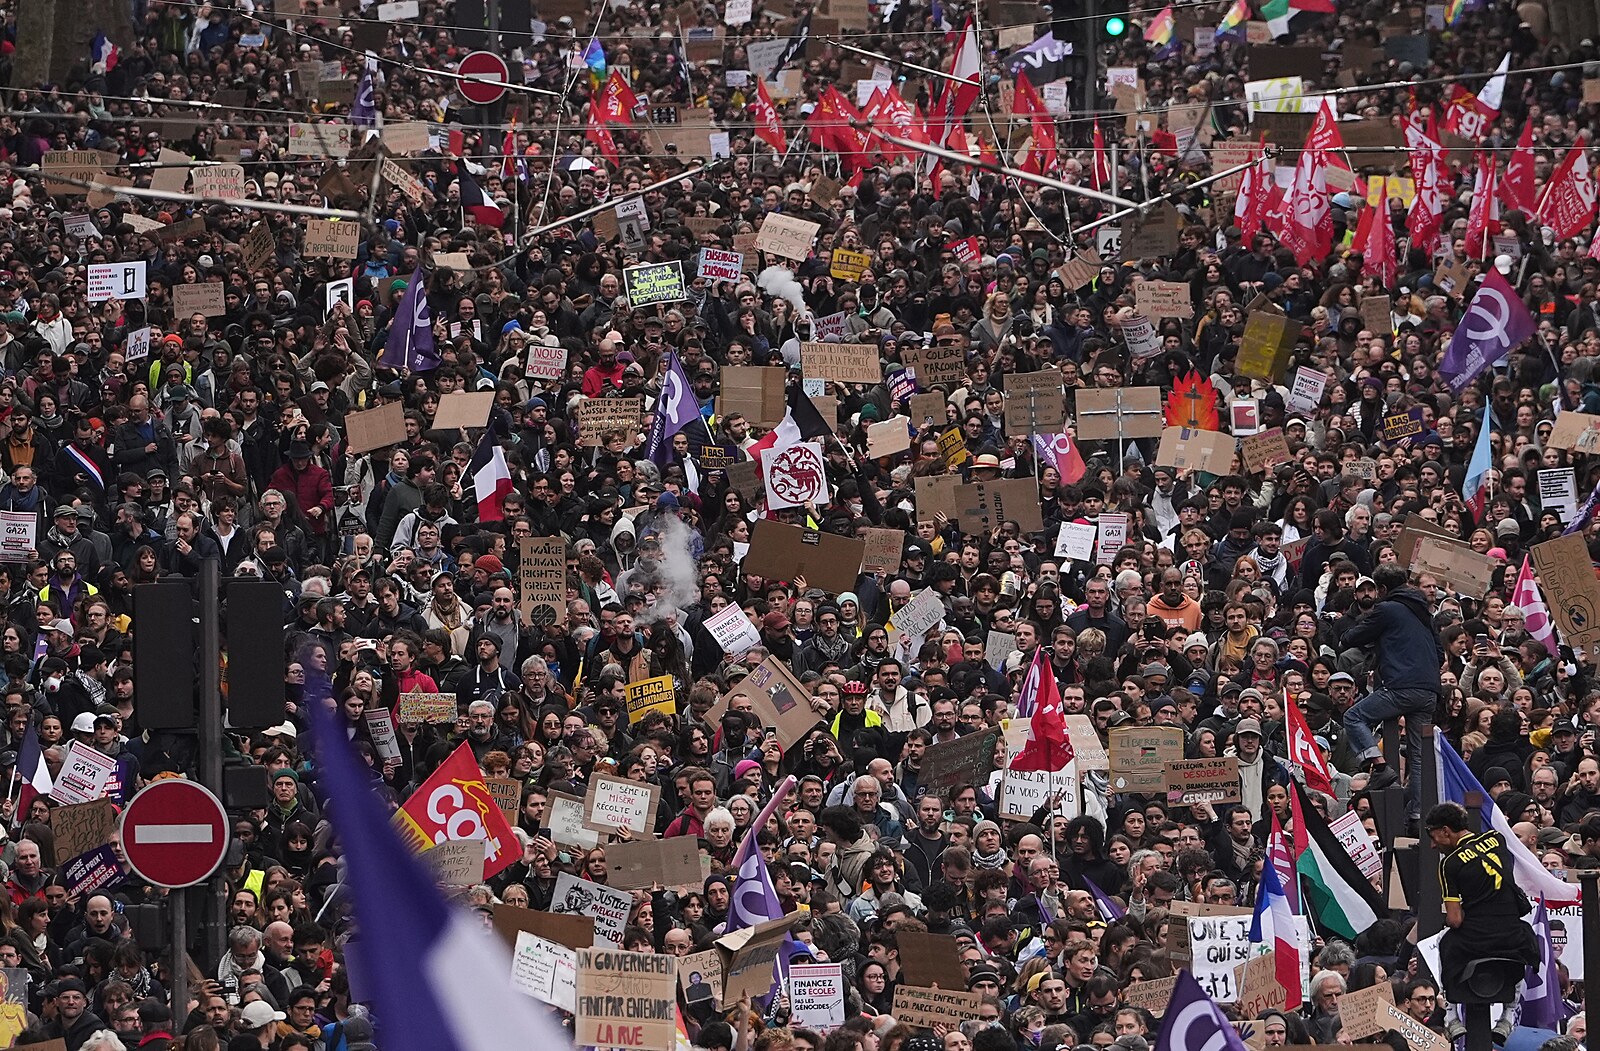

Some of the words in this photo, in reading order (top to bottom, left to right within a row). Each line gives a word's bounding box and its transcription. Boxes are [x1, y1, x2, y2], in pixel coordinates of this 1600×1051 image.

[73, 153, 98, 165] FUTUR
[621, 204, 638, 213] GAZA
[330, 222, 358, 237] REICH
[763, 224, 778, 235] MA
[780, 228, 807, 242] FORCE
[325, 234, 338, 243] OU
[533, 348, 564, 360] NOUS
[904, 353, 920, 364] LA
[924, 360, 964, 374] PARCOURT
[929, 374, 941, 383] LA
[942, 373, 956, 381] RUE
[580, 408, 607, 416] LAISSER
[1392, 414, 1409, 425] BAS
[708, 448, 724, 458] BAS
[5, 527, 27, 536] GAZA
[1104, 529, 1121, 538] GAZA
[530, 546, 563, 555] MAKE
[522, 557, 563, 567] HUMAN
[522, 569, 563, 579] RIGHTS
[524, 581, 562, 591] GREAT
[527, 593, 562, 602] AGAIN
[921, 608, 941, 627] NOUS
[713, 615, 740, 634] FINANCEZ
[716, 630, 726, 638] LES
[631, 685, 642, 700] LE
[642, 681, 664, 696] BAC
[635, 699, 644, 708] LES
[643, 690, 673, 707] MATRAQUES
[1207, 760, 1226, 768] C'EST
[72, 762, 97, 780] GAZA
[1036, 771, 1046, 784] DE
[1052, 773, 1075, 787] HAUT?
[1185, 781, 1221, 790] BRANCHEZ
[1221, 780, 1239, 788] VOTRE
[599, 783, 614, 792] QUI
[640, 790, 649, 798] LA
[1004, 784, 1016, 796] ON
[1019, 786, 1039, 798] VOUS
[609, 793, 635, 806] MISÈRE
[1182, 792, 1225, 804] CERVEAU
[596, 801, 630, 815] RÉCOLTE
[1008, 803, 1022, 814] EN
[606, 813, 632, 825] COLÈRE
[65, 857, 84, 880] BAISSE
[74, 868, 86, 881] DES
[93, 863, 107, 879] DES
[594, 887, 630, 911] JUSTICE
[605, 916, 618, 928] LES
[607, 926, 624, 944] LBD
[1190, 919, 1231, 942] UNE
[545, 945, 554, 954] 16
[1207, 942, 1231, 964] QUI
[577, 951, 591, 970] UN
[594, 952, 677, 976] GOUVERNEMENT
[677, 954, 704, 967] VOUS
[794, 979, 834, 989] FINANCEZ
[794, 989, 807, 997] LES
[808, 986, 837, 997] ÉCOLES
[895, 987, 905, 996] LE
[933, 993, 968, 1006] ENFREINT
[969, 999, 979, 1010] LA
[578, 996, 606, 1018] FINIT
[604, 996, 624, 1018] PAR
[626, 997, 675, 1021] ENTENDRE
[794, 1003, 830, 1012] GÉNOCIDES
[894, 999, 909, 1009] LOI
[912, 1002, 933, 1012] PARCE
[935, 1005, 957, 1017] QU'ILS
[898, 1014, 914, 1023] RIEN
[1387, 1006, 1437, 1043] ENTENDEZ
[595, 1023, 614, 1045] LA
[617, 1025, 645, 1046] RUE
[1400, 1025, 1431, 1049] VOUS?
